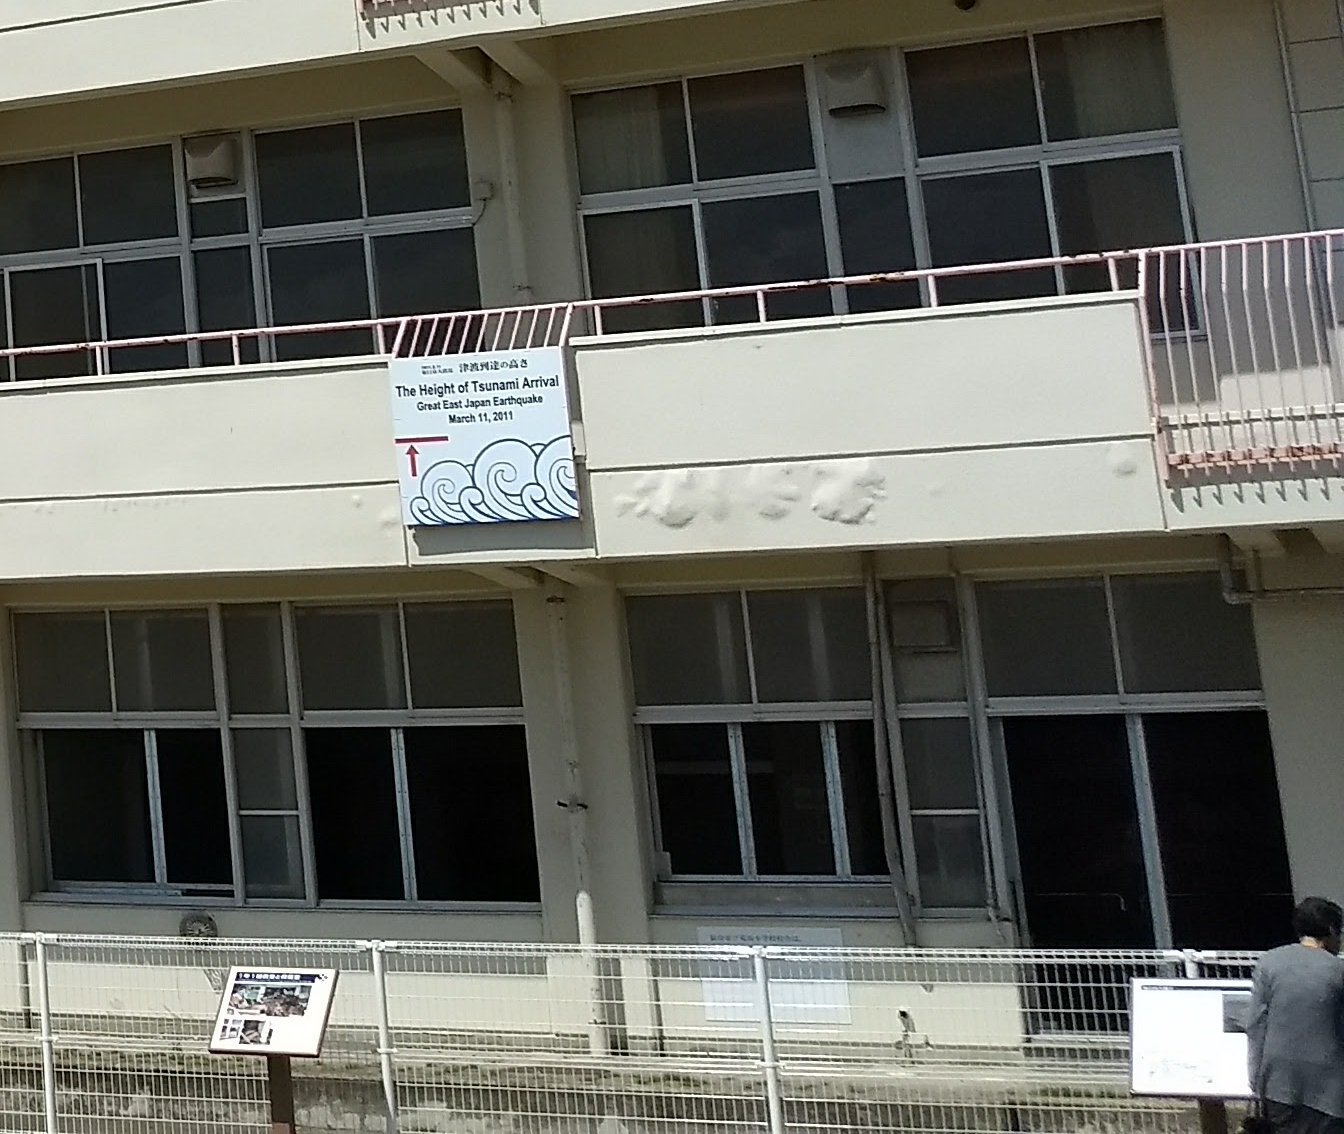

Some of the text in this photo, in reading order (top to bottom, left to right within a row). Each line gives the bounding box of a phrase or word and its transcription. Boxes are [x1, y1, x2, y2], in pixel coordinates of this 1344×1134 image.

[459, 358, 529, 374] 津波到達の高さ
[395, 374, 560, 398] The Height of Tsunami Arrival
[416, 393, 544, 412] Great East Japan Earthquake
[448, 410, 514, 425] March 11, 2011
